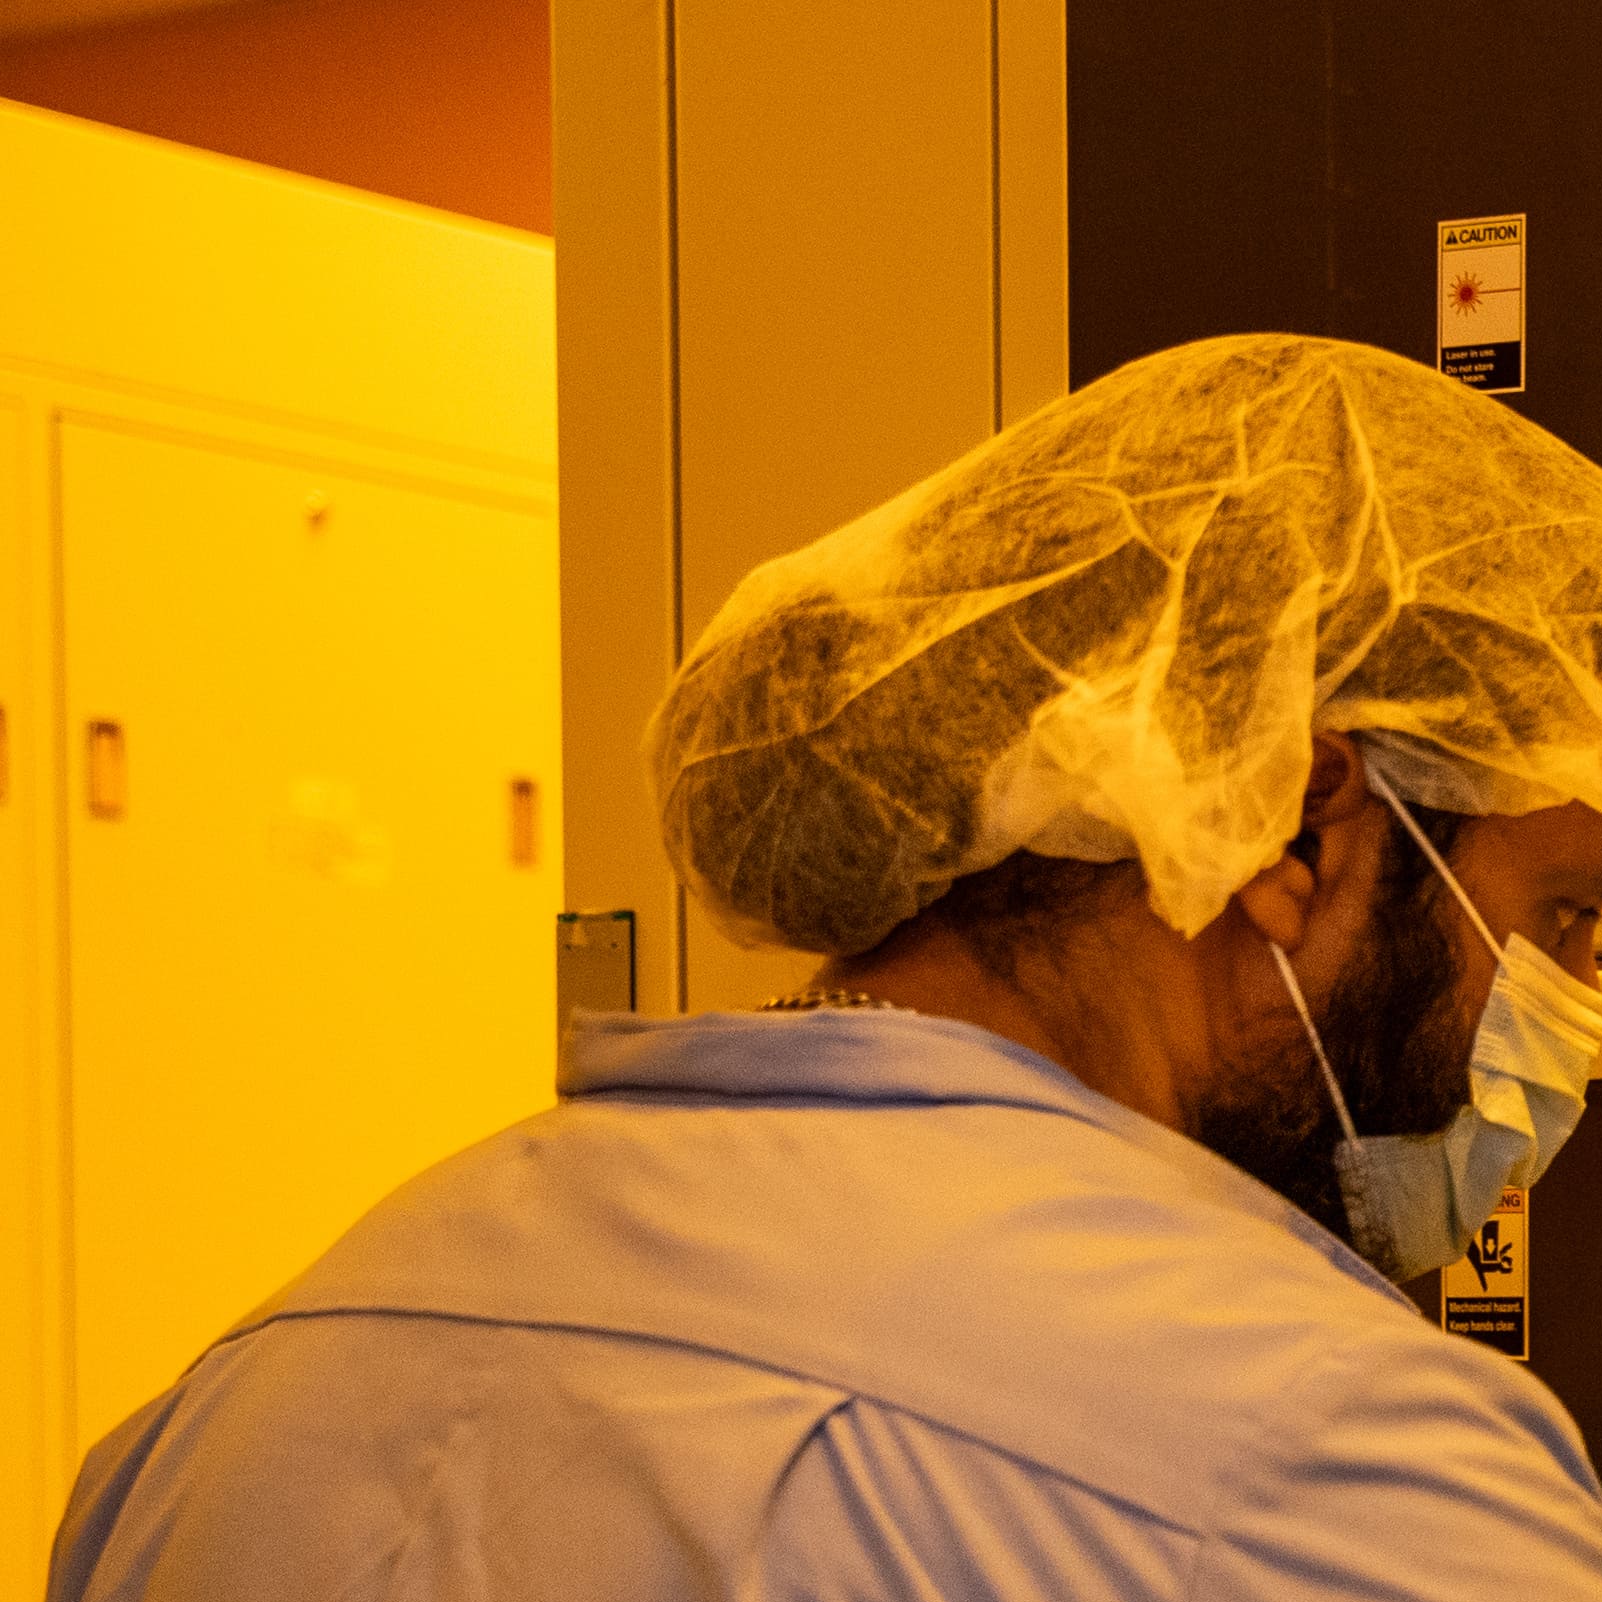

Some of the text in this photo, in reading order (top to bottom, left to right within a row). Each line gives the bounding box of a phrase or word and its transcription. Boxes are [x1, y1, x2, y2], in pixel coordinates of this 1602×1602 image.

[1459, 225, 1517, 244] CAUTION
[1446, 351, 1468, 360] Laser
[1470, 350, 1478, 358] in
[1446, 365, 1457, 373] Do
[1459, 364, 1472, 372] not
[1474, 363, 1494, 371] stare
[1450, 1302, 1491, 1312] Mechanical
